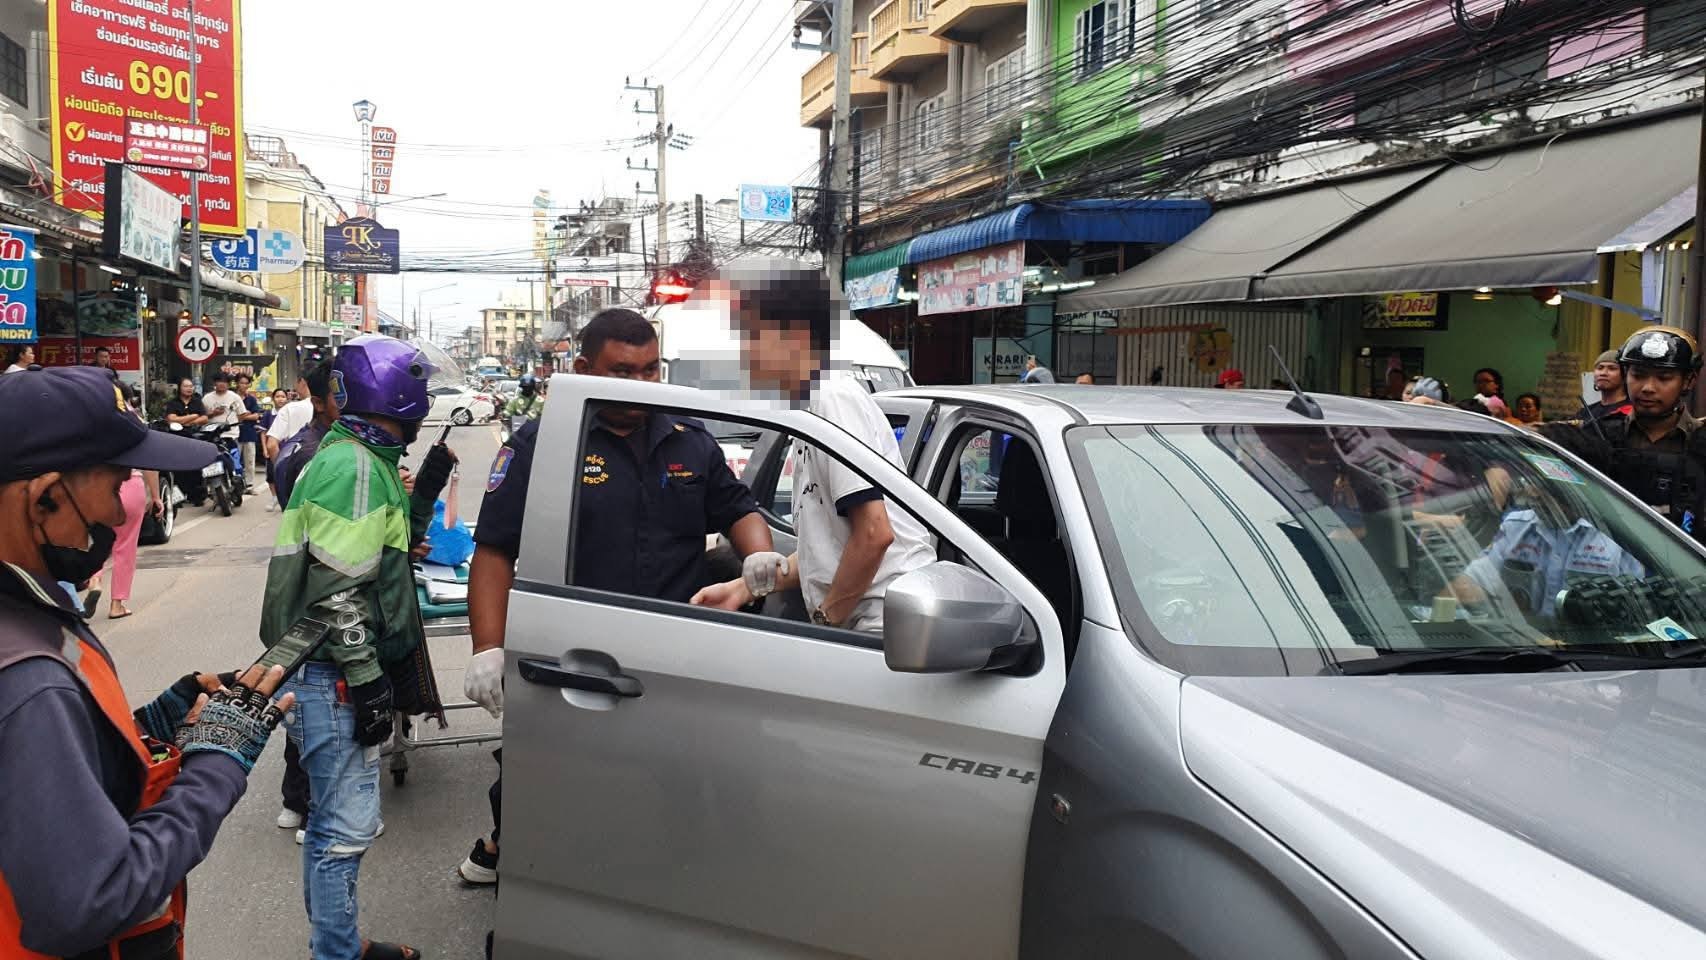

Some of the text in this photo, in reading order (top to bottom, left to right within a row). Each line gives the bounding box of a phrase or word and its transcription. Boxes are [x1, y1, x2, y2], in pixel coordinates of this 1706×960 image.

[96, 26, 202, 64] ซ่อมด่วนรอรับได้เย
[81, 66, 124, 91] เริ่มต้น
[770, 198, 786, 209] 24
[224, 256, 251, 269] 药店
[260, 256, 298, 266] Pharmacy
[0, 328, 33, 341] NDRY
[183, 336, 211, 353] 40
[984, 354, 1025, 365] KRARI
